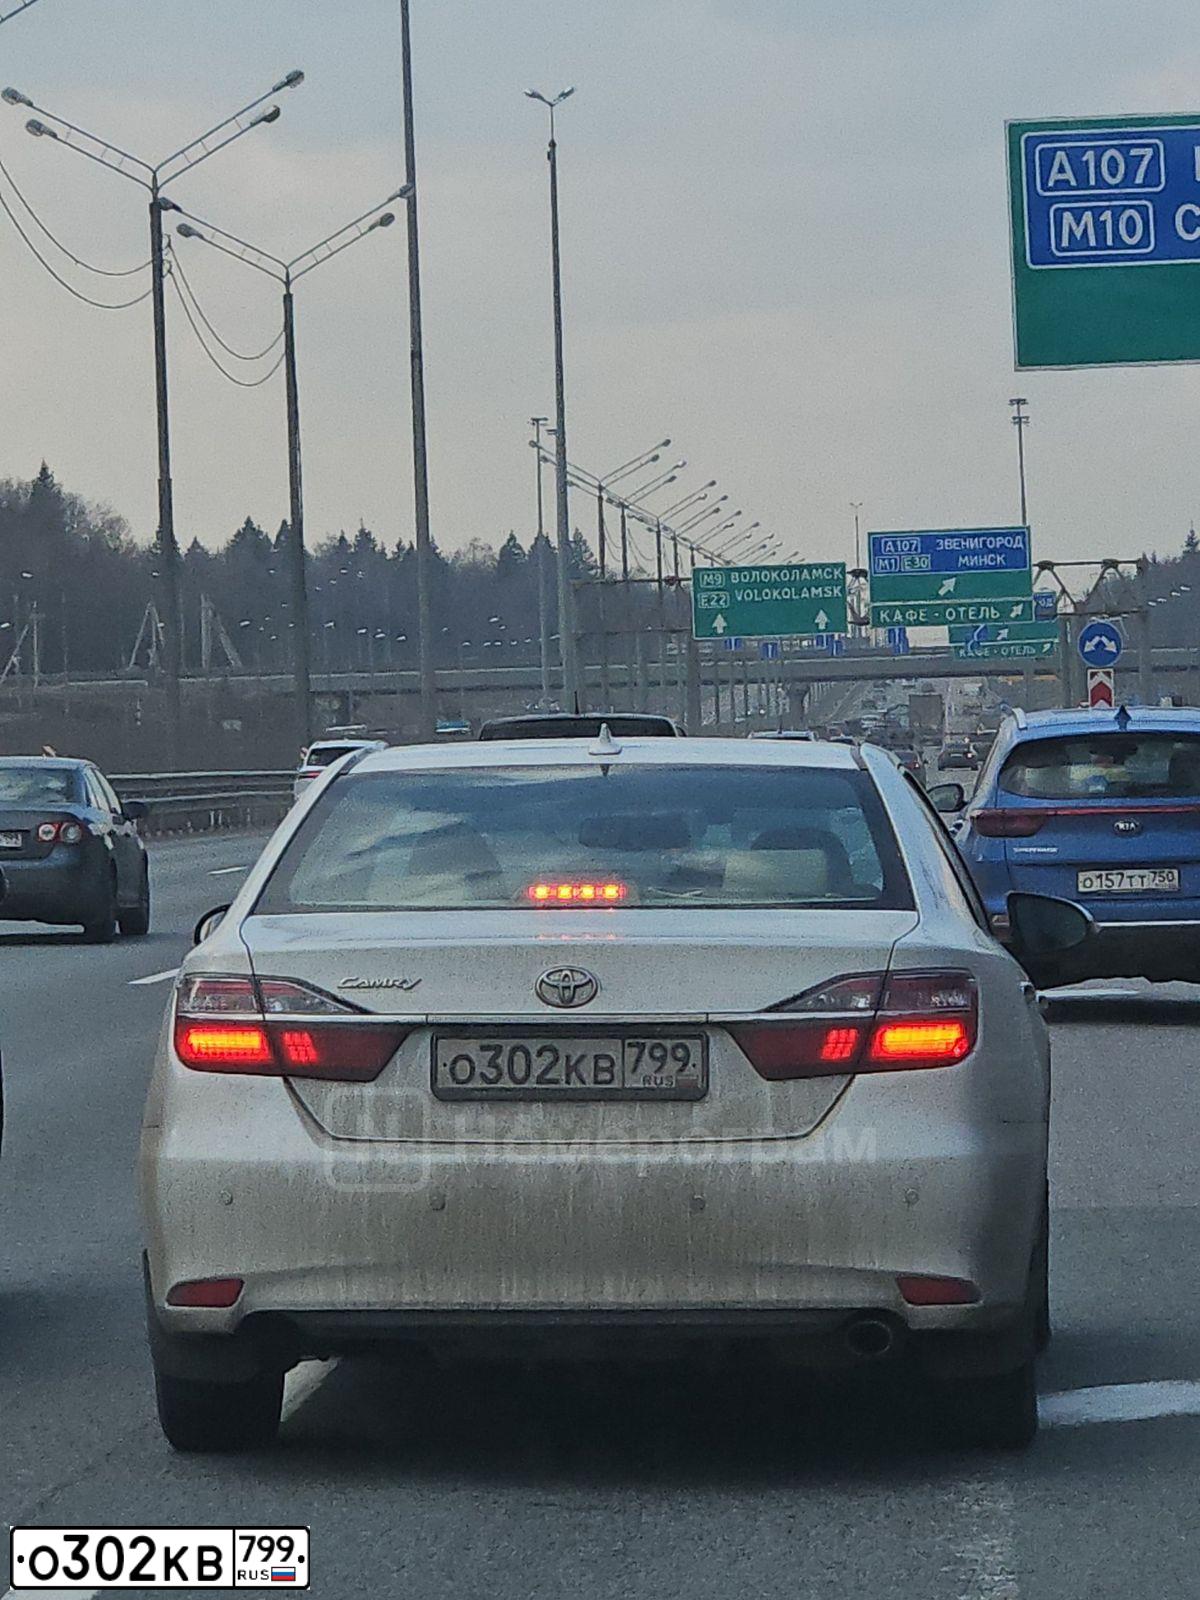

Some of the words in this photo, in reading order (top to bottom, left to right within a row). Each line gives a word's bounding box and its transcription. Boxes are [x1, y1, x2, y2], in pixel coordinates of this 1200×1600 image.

[1047, 148, 1154, 187] А107
[1060, 209, 1144, 247] М10
[885, 539, 917, 553] А107
[936, 536, 1025, 550] ЗВЕНИГОРОД
[878, 557, 896, 570] М1
[903, 556, 928, 569] E30
[958, 554, 1006, 568] МИНСК
[702, 573, 721, 586] М9
[730, 567, 844, 584] ВОЛОКОЛАМСК
[701, 594, 726, 606] E22
[735, 586, 842, 602] VOLOKOLAMSK
[879, 608, 928, 624] КАФЕ
[945, 606, 1000, 620] ОТЕЛЬ
[627, 1041, 691, 1074] 799
[642, 1074, 674, 1087] RUS
